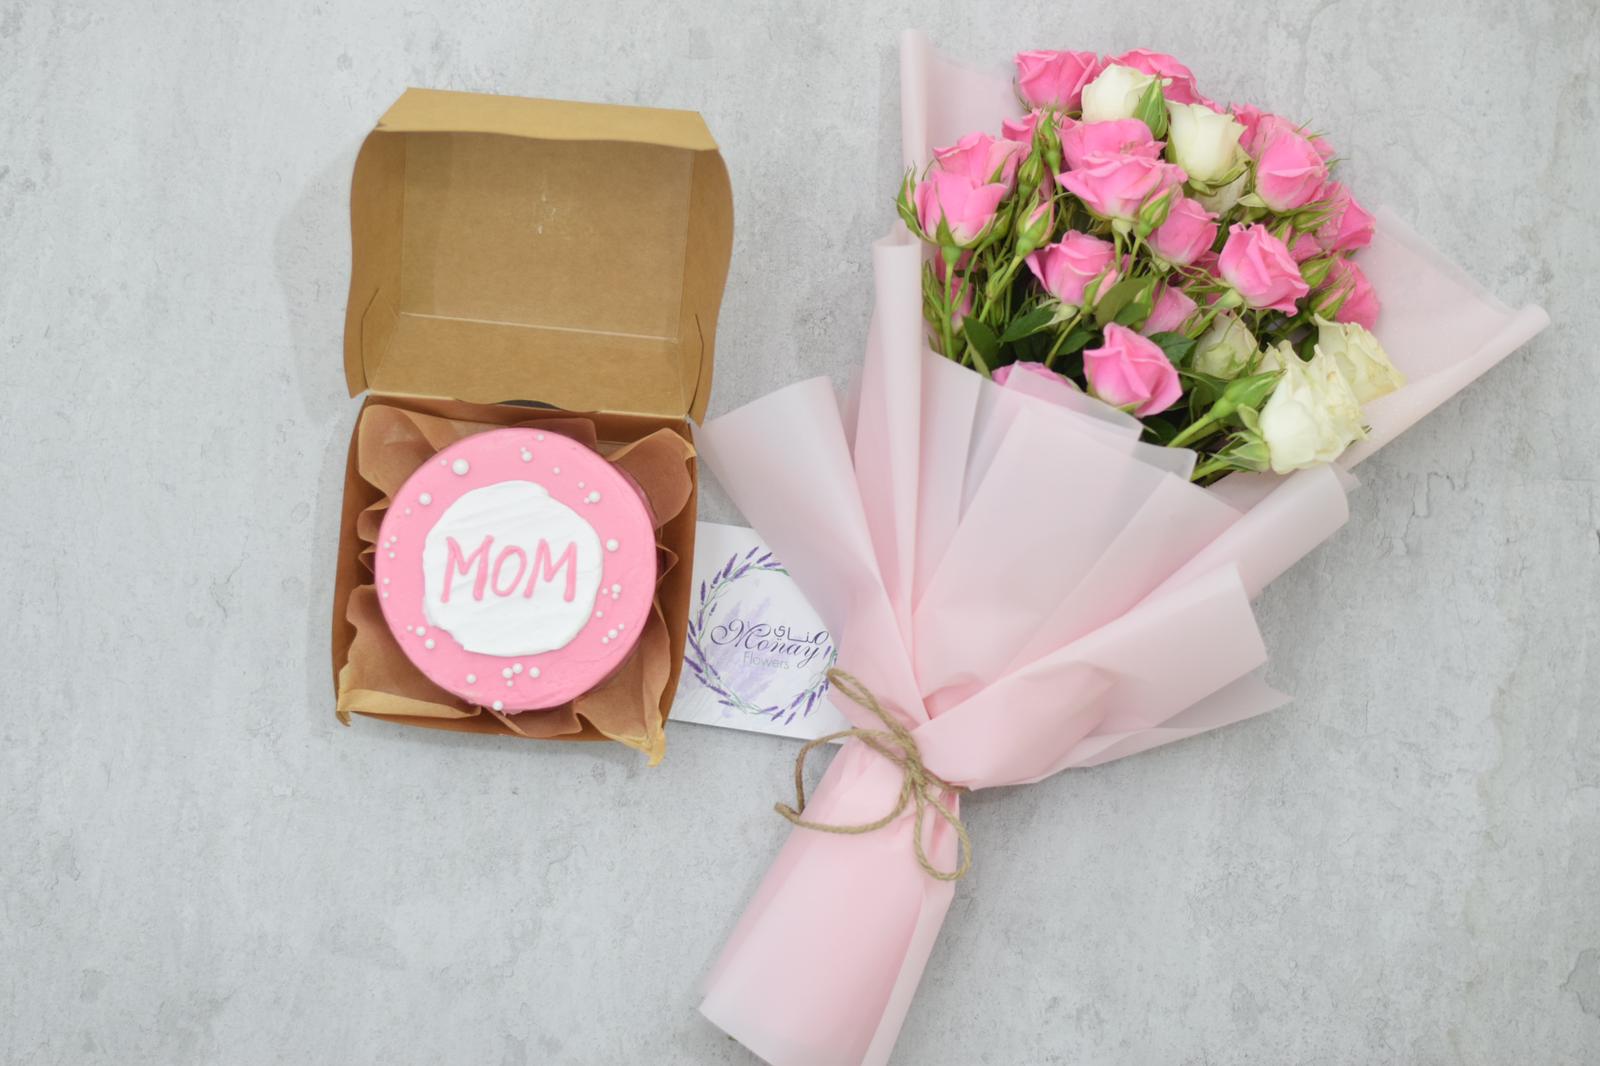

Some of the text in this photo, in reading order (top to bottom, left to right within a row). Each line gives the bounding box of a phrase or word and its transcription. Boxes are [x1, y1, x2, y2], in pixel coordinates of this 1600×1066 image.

[440, 535, 578, 603] MOM
[710, 619, 820, 669] Monay
[743, 650, 790, 670] Flowers
